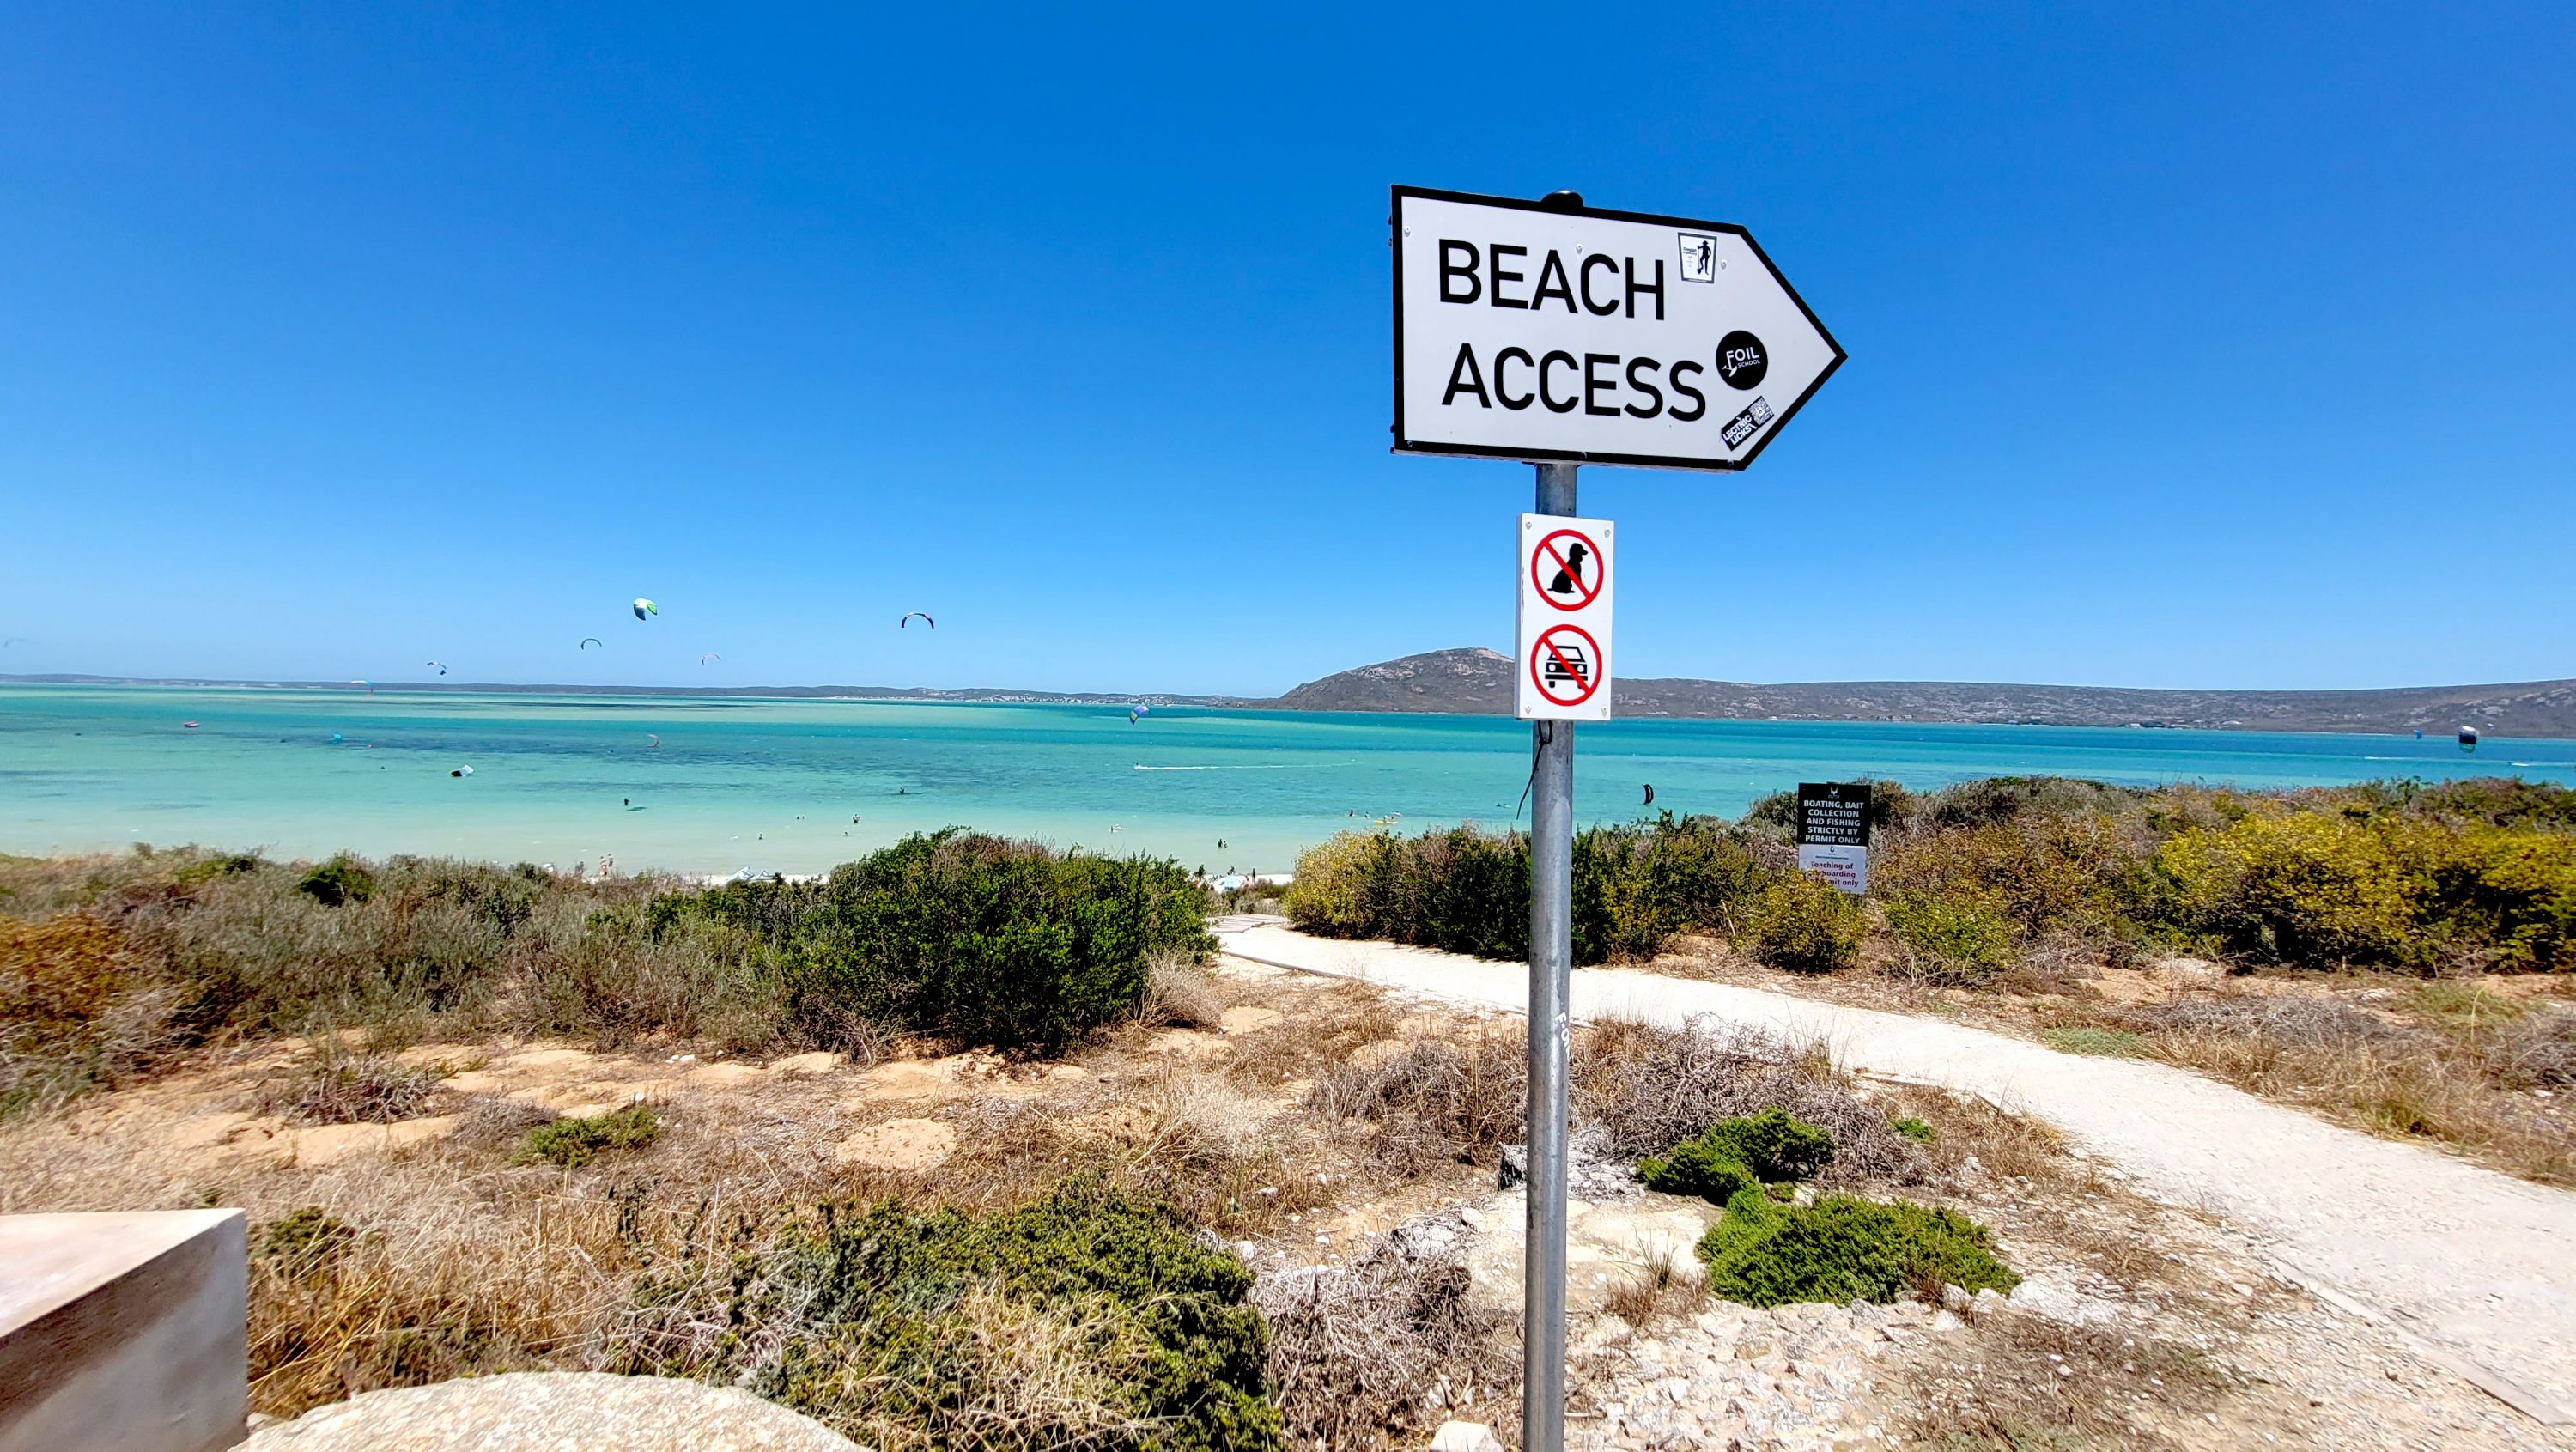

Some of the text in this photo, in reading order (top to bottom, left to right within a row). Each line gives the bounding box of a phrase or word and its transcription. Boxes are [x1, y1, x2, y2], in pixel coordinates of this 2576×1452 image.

[1438, 238, 1665, 321] BEACH
[1726, 347, 1759, 366] FOIL
[1442, 342, 1707, 422] ACCESS
[1803, 799, 1843, 809] BOATING,
[1807, 809, 1859, 817] COLLECTION
[1826, 818, 1861, 827] FISHING
[1807, 826, 1845, 835] STRICTLY
[1805, 835, 1836, 843] PERMIT
